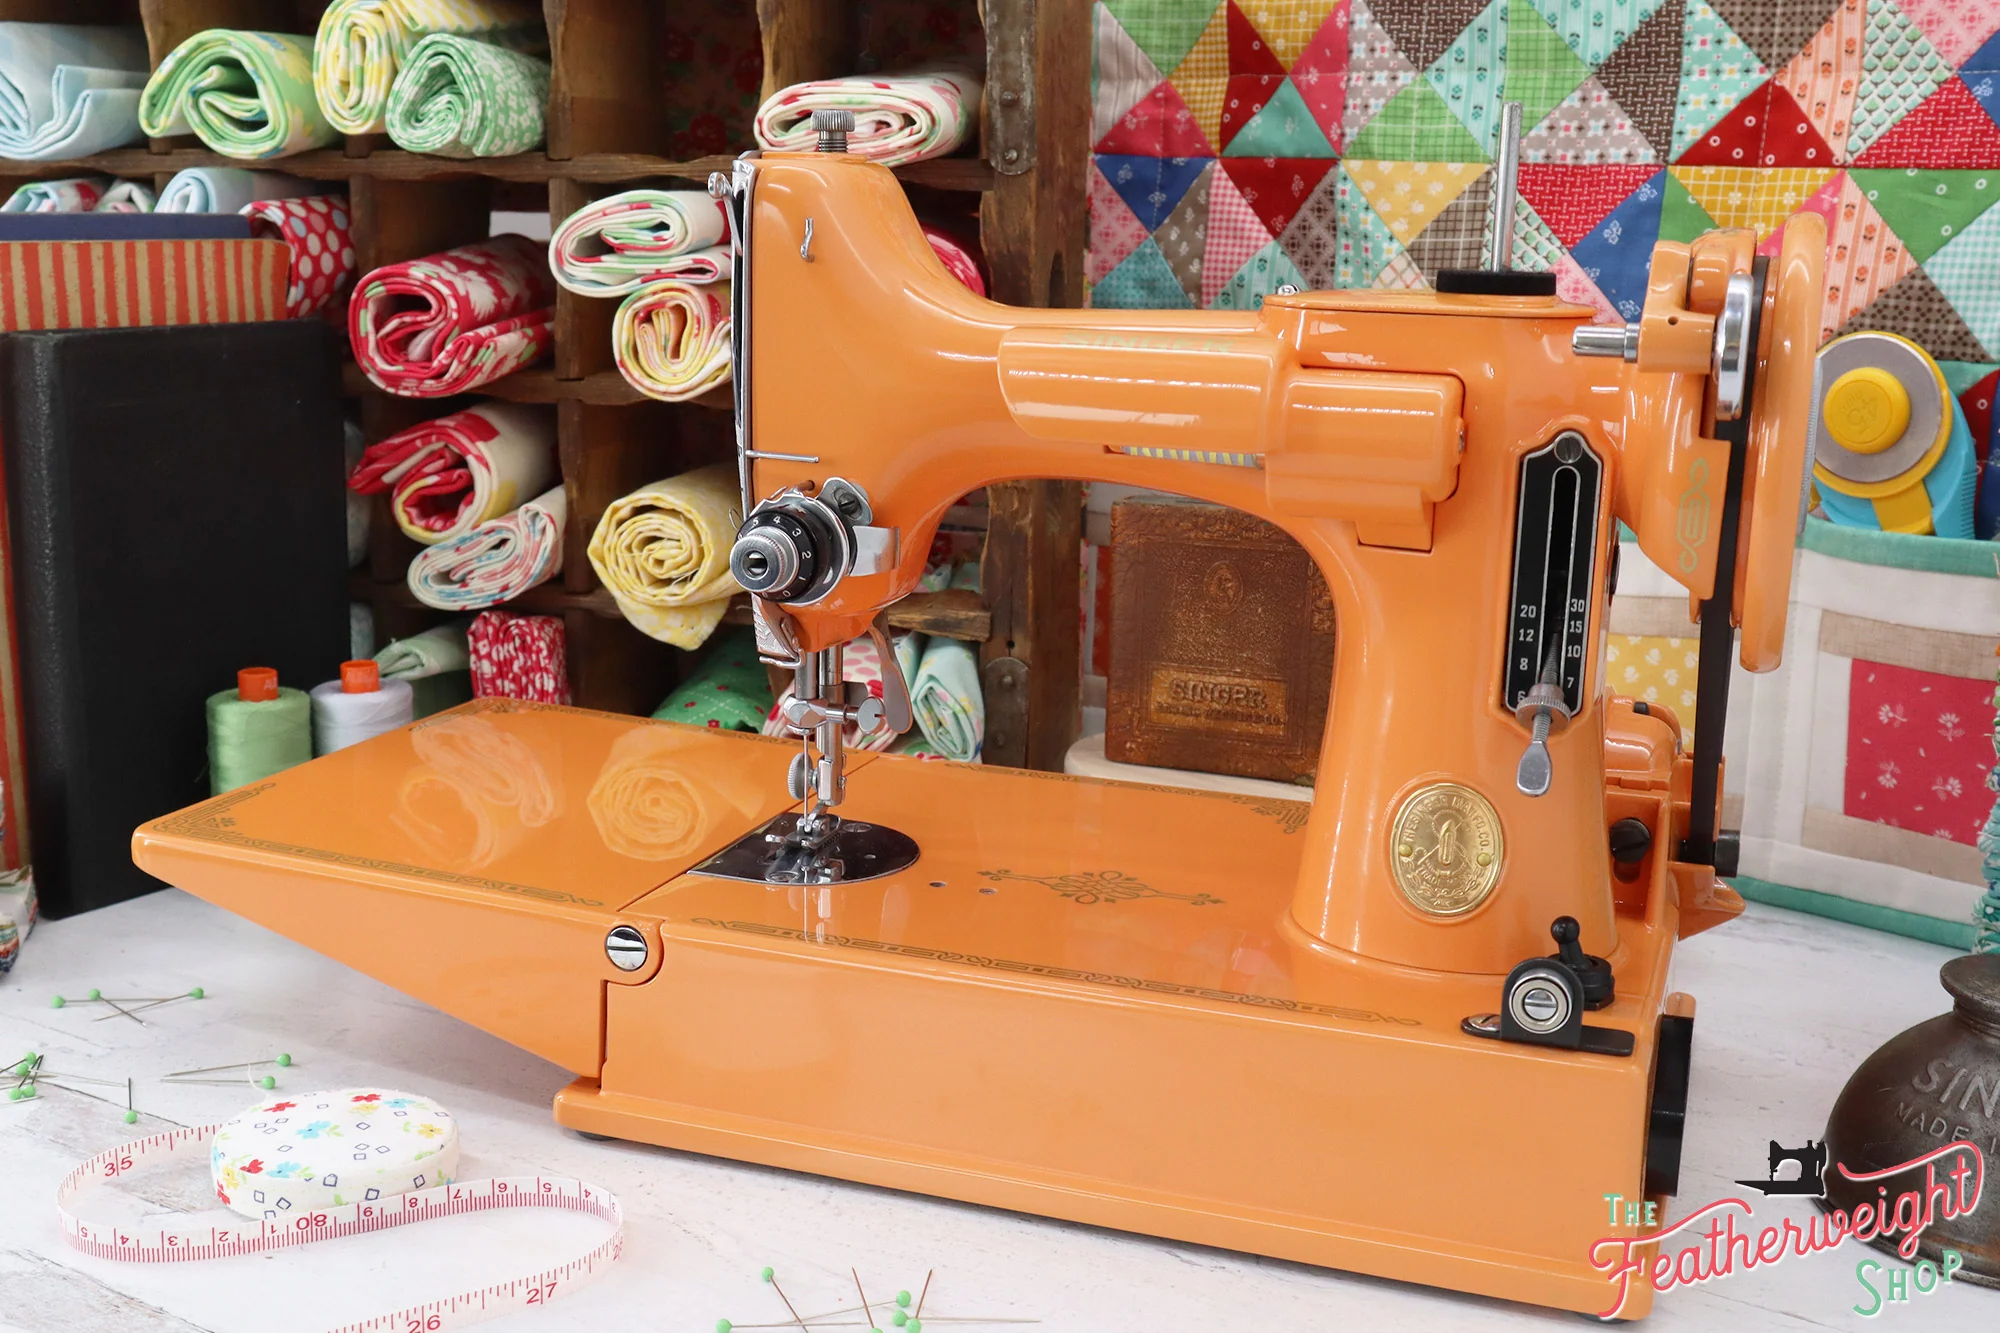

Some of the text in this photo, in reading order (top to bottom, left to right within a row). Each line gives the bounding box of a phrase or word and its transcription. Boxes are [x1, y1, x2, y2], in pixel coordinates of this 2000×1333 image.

[752, 517, 758, 526] 5
[773, 516, 780, 524] 4
[792, 528, 801, 537] 3
[802, 551, 811, 559] 2
[782, 590, 791, 598] 0
[1520, 605, 1536, 618] 20
[1570, 599, 1584, 612] 30
[1569, 620, 1583, 634] 15
[1518, 629, 1534, 642] 12
[1566, 645, 1581, 658] 10
[1520, 658, 1528, 671] 8
[1567, 677, 1574, 688] 7
[1170, 679, 1267, 709] SINGER
[1893, 1101, 1971, 1143] MADE
[104, 1156, 133, 1177] 35
[542, 1182, 552, 1193] 5
[584, 1188, 592, 1198] 4
[453, 1188, 463, 1200] 7
[408, 1197, 418, 1208] 8
[80, 1226, 89, 1238] 5
[270, 1224, 278, 1235] 1
[119, 1234, 130, 1245] 4
[168, 1235, 178, 1247] 3
[218, 1230, 230, 1242] 2
[407, 1314, 441, 1333] 26
[526, 1282, 557, 1305] 27
